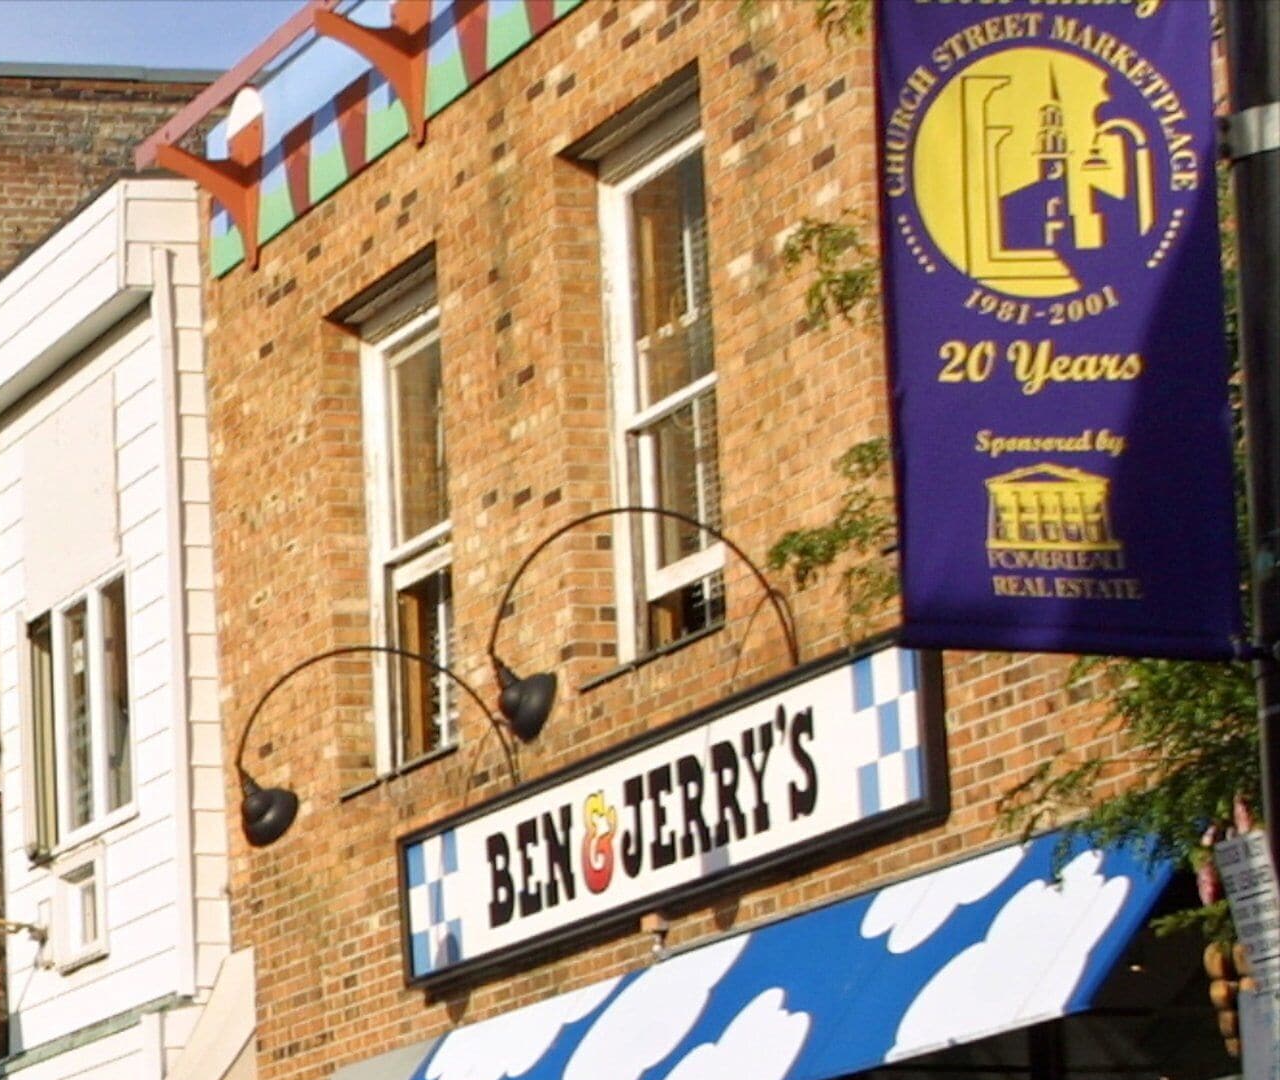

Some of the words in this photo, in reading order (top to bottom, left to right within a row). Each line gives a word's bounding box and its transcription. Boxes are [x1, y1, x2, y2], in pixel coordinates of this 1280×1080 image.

[886, 66, 937, 197] CHURCH
[932, 12, 1042, 70] STREET
[1050, 15, 1199, 191] MARKETPLACE
[964, 285, 1120, 325] 1981-2001
[939, 340, 997, 382] 20
[1007, 338, 1144, 395] Years
[975, 429, 1092, 458] Sponsored
[1095, 428, 1127, 457] by
[992, 574, 1051, 597] REAL
[1054, 577, 1143, 599] ESTATE
[486, 804, 576, 929] BEN
[581, 790, 617, 895] &
[620, 703, 818, 878] JERRY'S
